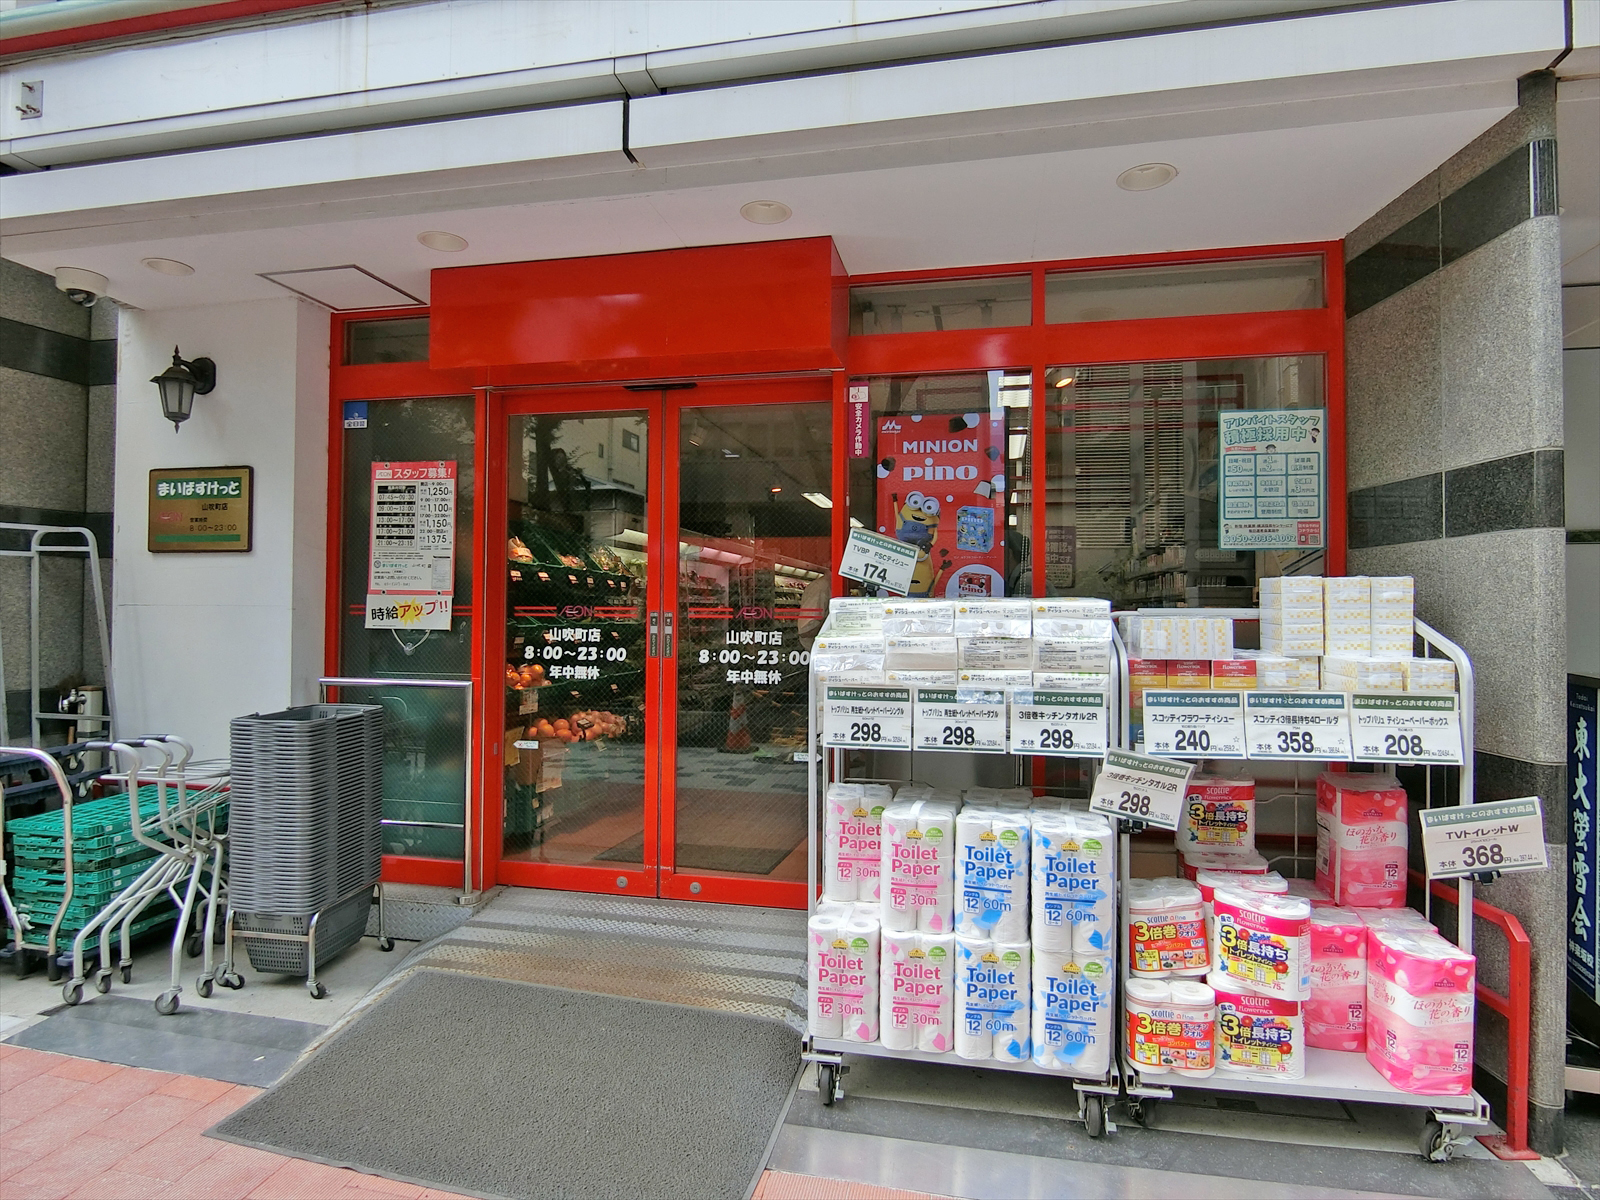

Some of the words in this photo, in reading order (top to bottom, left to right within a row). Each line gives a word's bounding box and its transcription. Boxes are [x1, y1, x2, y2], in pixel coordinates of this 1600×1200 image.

[854, 402, 863, 457] 安全カメラ作動中
[1223, 414, 1320, 429] アルバイトスタッフ
[1223, 426, 1307, 445] 積極採用中
[902, 439, 979, 454] MINION
[902, 457, 979, 481] pino
[158, 481, 240, 497] まいばすけっと
[427, 486, 449, 497] 1,250
[427, 504, 449, 513] 1,100
[426, 519, 447, 528] 1,150
[863, 562, 888, 583] 174
[549, 627, 601, 643] 山吹町店
[726, 630, 783, 646] 山吹町店
[524, 646, 627, 662] 8:00〜23:00
[549, 665, 600, 681] 年中無休
[726, 670, 782, 685] 年中無休
[828, 690, 908, 699] まいばすけっとのおすすめ商品
[1147, 696, 1238, 704] まいばすけっとのおすすめ商品
[1249, 697, 1343, 705] まいばすけっとのおすすめ商品
[1354, 698, 1453, 708] まいばすけっとのおすすめ商品
[1018, 711, 1098, 721] 3倍巻キッチンタオル2R
[1152, 713, 1235, 723] スコッティフラワーティシュー
[1253, 715, 1339, 725] スコッティ3倍長持ち4ロールダ
[850, 722, 881, 742] 298
[942, 726, 975, 746] 298
[1040, 728, 1074, 749] 298
[1175, 729, 1210, 751] 240
[1277, 731, 1314, 753] 358
[1362, 745, 1379, 753] 本体
[1384, 734, 1423, 756] 208
[1106, 772, 1178, 792] 3倍巻キッチンタオル2R
[1100, 797, 1114, 807] 本体
[1118, 790, 1151, 816] 298
[1189, 803, 1248, 822] 3倍長持ち
[1426, 804, 1534, 823] まいばすけっとのおすすめ商品
[839, 821, 881, 836] Toilet
[1345, 824, 1385, 837] ほのかな
[1446, 824, 1519, 840] TVトイレットW
[1360, 832, 1397, 845] 花の香り
[892, 843, 938, 860] Toilet
[964, 845, 1013, 865] Toilet
[1439, 860, 1457, 868] 本体
[1462, 843, 1504, 867] 368
[839, 868, 851, 878] 12
[856, 867, 880, 878] 30m
[891, 858, 941, 877] Paper
[965, 861, 1015, 881] Paper
[1045, 856, 1097, 875] Toilet
[1386, 869, 1397, 877] 12
[1046, 872, 1099, 891] Paper
[892, 895, 905, 906] 12
[910, 895, 937, 906] 30m
[966, 898, 979, 909] 12
[983, 898, 1011, 912] 60m
[1047, 910, 1061, 922] 12
[1066, 910, 1097, 922] 60m
[1147, 915, 1168, 924] scottie
[1239, 910, 1266, 925] scottie
[1135, 921, 1177, 941] 3倍巻
[1220, 925, 1288, 961] 3倍長持ち
[818, 952, 864, 971] Toilet
[818, 968, 866, 987] Paper
[893, 962, 941, 980] Toilet
[966, 967, 1015, 986] Toilet
[1320, 970, 1360, 982] 花の香り
[893, 977, 943, 997] Paper
[966, 983, 1018, 1002] Paper
[1046, 976, 1098, 997] Toilet
[819, 1003, 833, 1014] 12
[837, 1003, 863, 1015] 30m
[1046, 993, 1100, 1013] Paper
[1240, 996, 1270, 1007] scottie
[1413, 998, 1457, 1010] ほのかな
[894, 1014, 907, 1025] 12
[912, 1013, 940, 1026] 30m
[1151, 1009, 1175, 1018] scottie
[1349, 1009, 1361, 1019] 12
[1429, 1006, 1471, 1020] 花の香り
[967, 1020, 981, 1031] 12
[985, 1019, 1014, 1032] 60m
[1136, 1012, 1182, 1036] 3倍巻
[1221, 1014, 1292, 1042] 3倍長持ち
[1047, 1030, 1061, 1042] 12
[1066, 1031, 1096, 1044] 60m
[1455, 1049, 1468, 1059] 12
